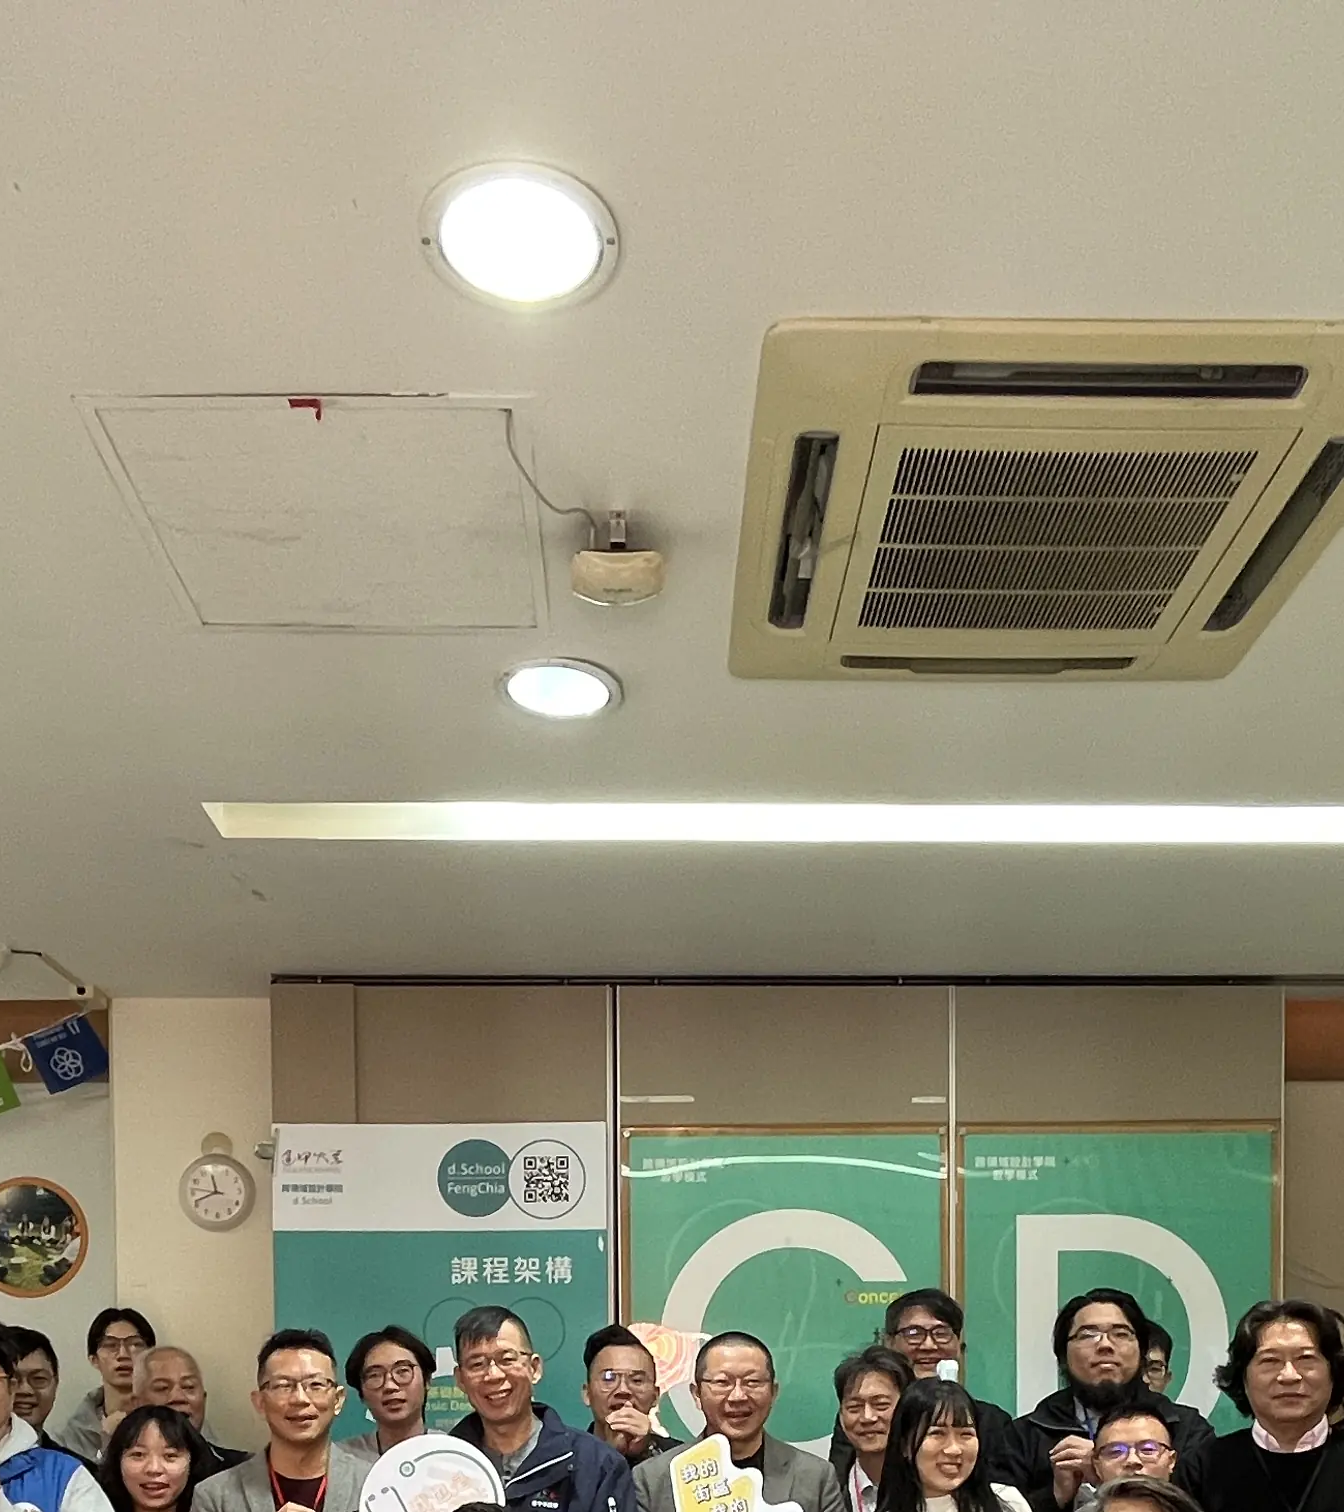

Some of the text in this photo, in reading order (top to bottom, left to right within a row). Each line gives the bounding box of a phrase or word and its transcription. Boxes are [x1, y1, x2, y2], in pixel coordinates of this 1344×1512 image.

[447, 1181, 506, 1198] FengChia
[451, 1255, 574, 1286] 課程架構
[681, 1458, 719, 1484] 我的
